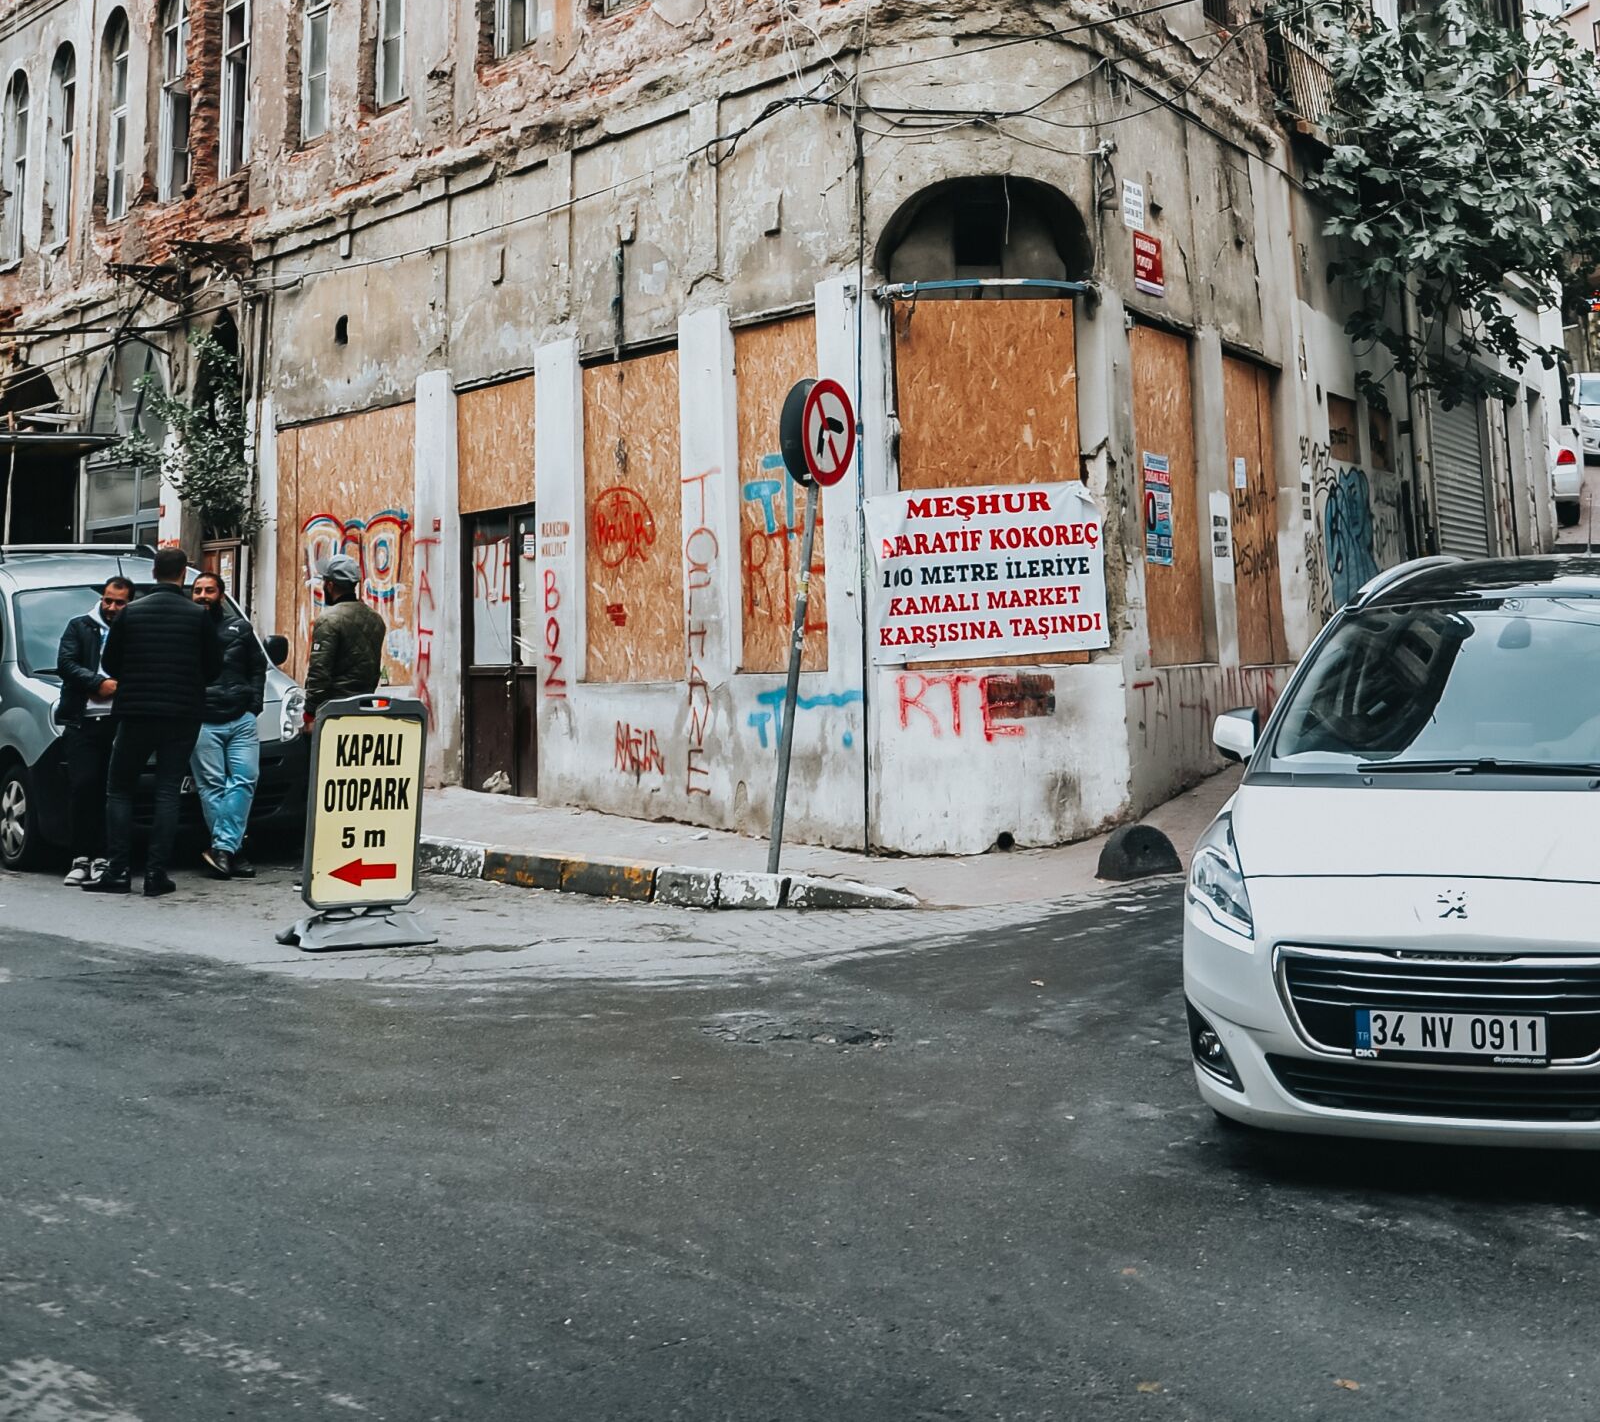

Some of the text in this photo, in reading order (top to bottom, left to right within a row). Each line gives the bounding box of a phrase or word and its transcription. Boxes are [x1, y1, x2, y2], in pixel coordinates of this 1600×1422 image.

[906, 491, 1051, 521] MEŞHUR
[990, 523, 1098, 550] KOKOREÇ
[883, 554, 1090, 588] 100 METRE İLERİYE
[889, 586, 1081, 616] KAMALI MARKET
[880, 613, 1102, 649] KARŞISINA TAŞINDI
[336, 734, 403, 767] KAPALI
[324, 778, 411, 813] OTOPARK
[341, 827, 386, 849] 5 m
[1357, 1030, 1370, 1042] TR
[1372, 1014, 1537, 1052] 34 NV 0911
[1355, 1048, 1379, 1058] DKY
